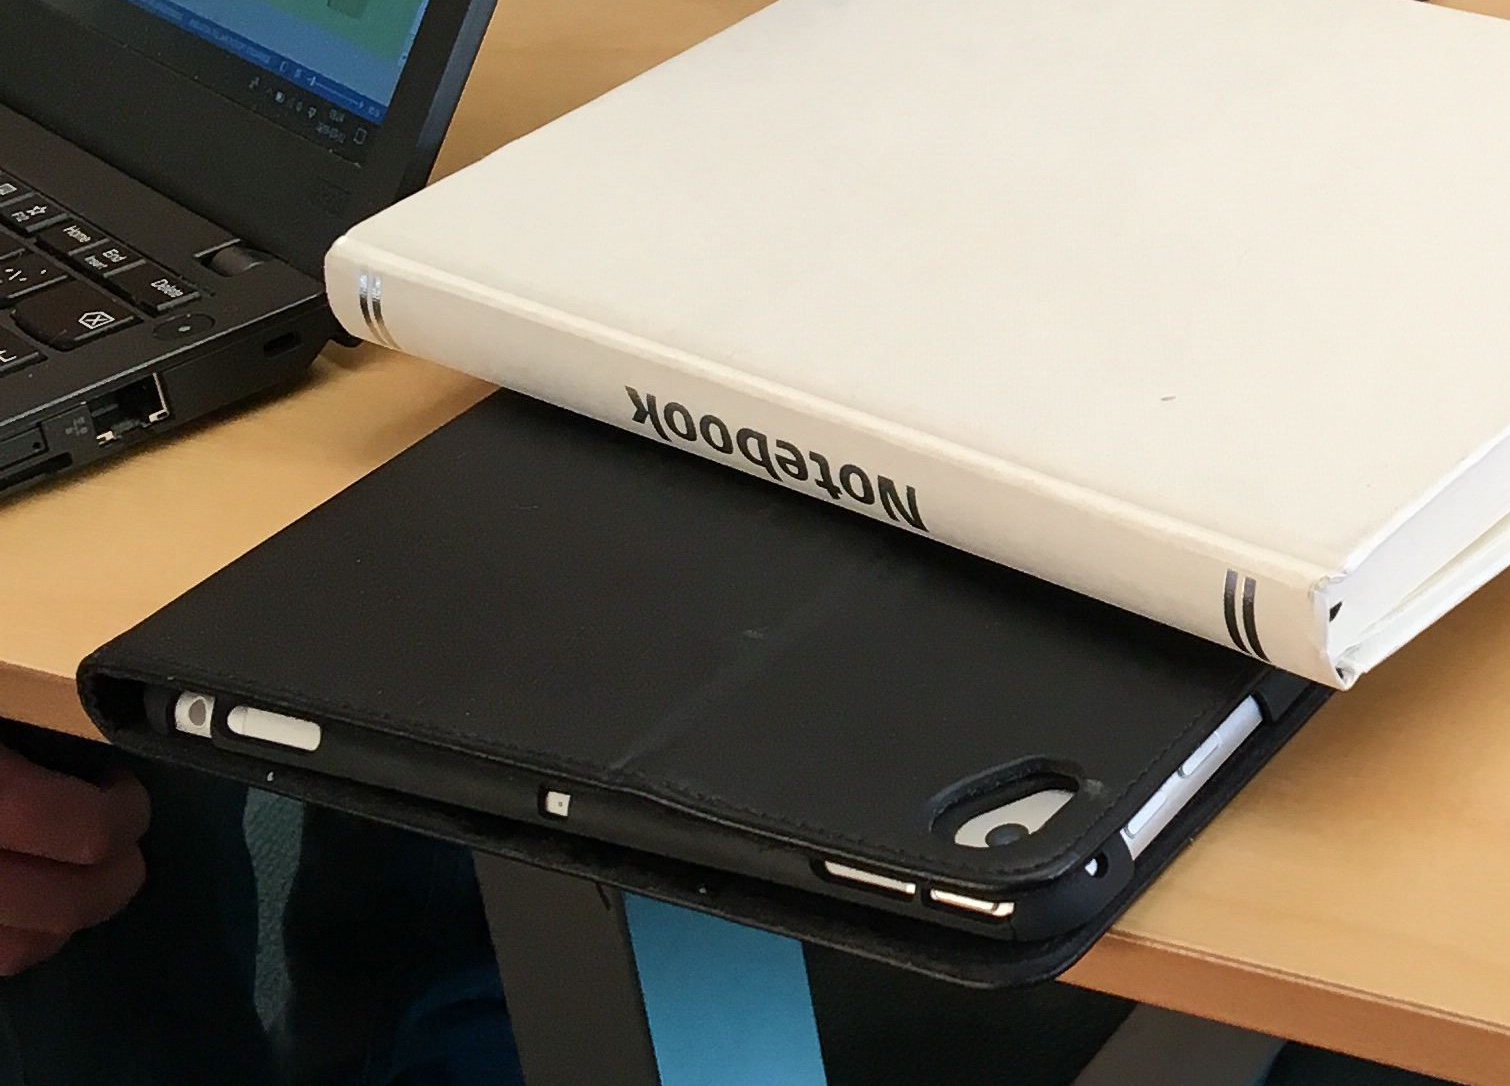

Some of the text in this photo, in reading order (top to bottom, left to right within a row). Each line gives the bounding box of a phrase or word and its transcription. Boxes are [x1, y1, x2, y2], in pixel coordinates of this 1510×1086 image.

[63, 225, 91, 242] Home
[102, 248, 127, 263] End
[151, 279, 183, 298] Delete
[625, 385, 929, 533] Notebook
